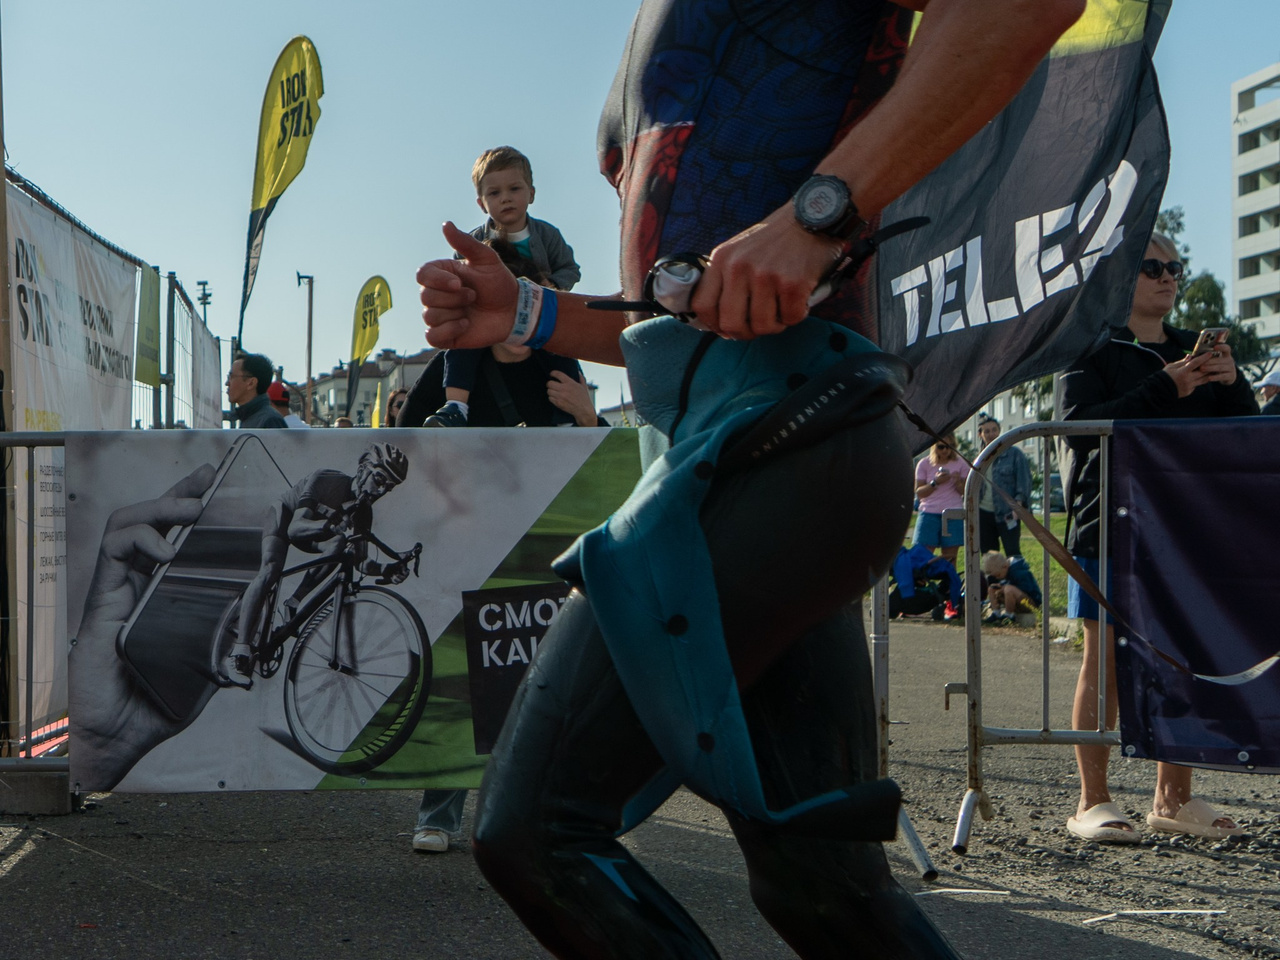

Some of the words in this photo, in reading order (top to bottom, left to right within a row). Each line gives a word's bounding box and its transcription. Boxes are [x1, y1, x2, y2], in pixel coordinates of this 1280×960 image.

[280, 67, 307, 109] IRON
[277, 98, 313, 148] STAR
[15, 237, 39, 285] IRON
[890, 159, 1138, 348] TELE2
[16, 284, 53, 347] STAR
[362, 291, 376, 310] IRO
[362, 305, 379, 330] STA
